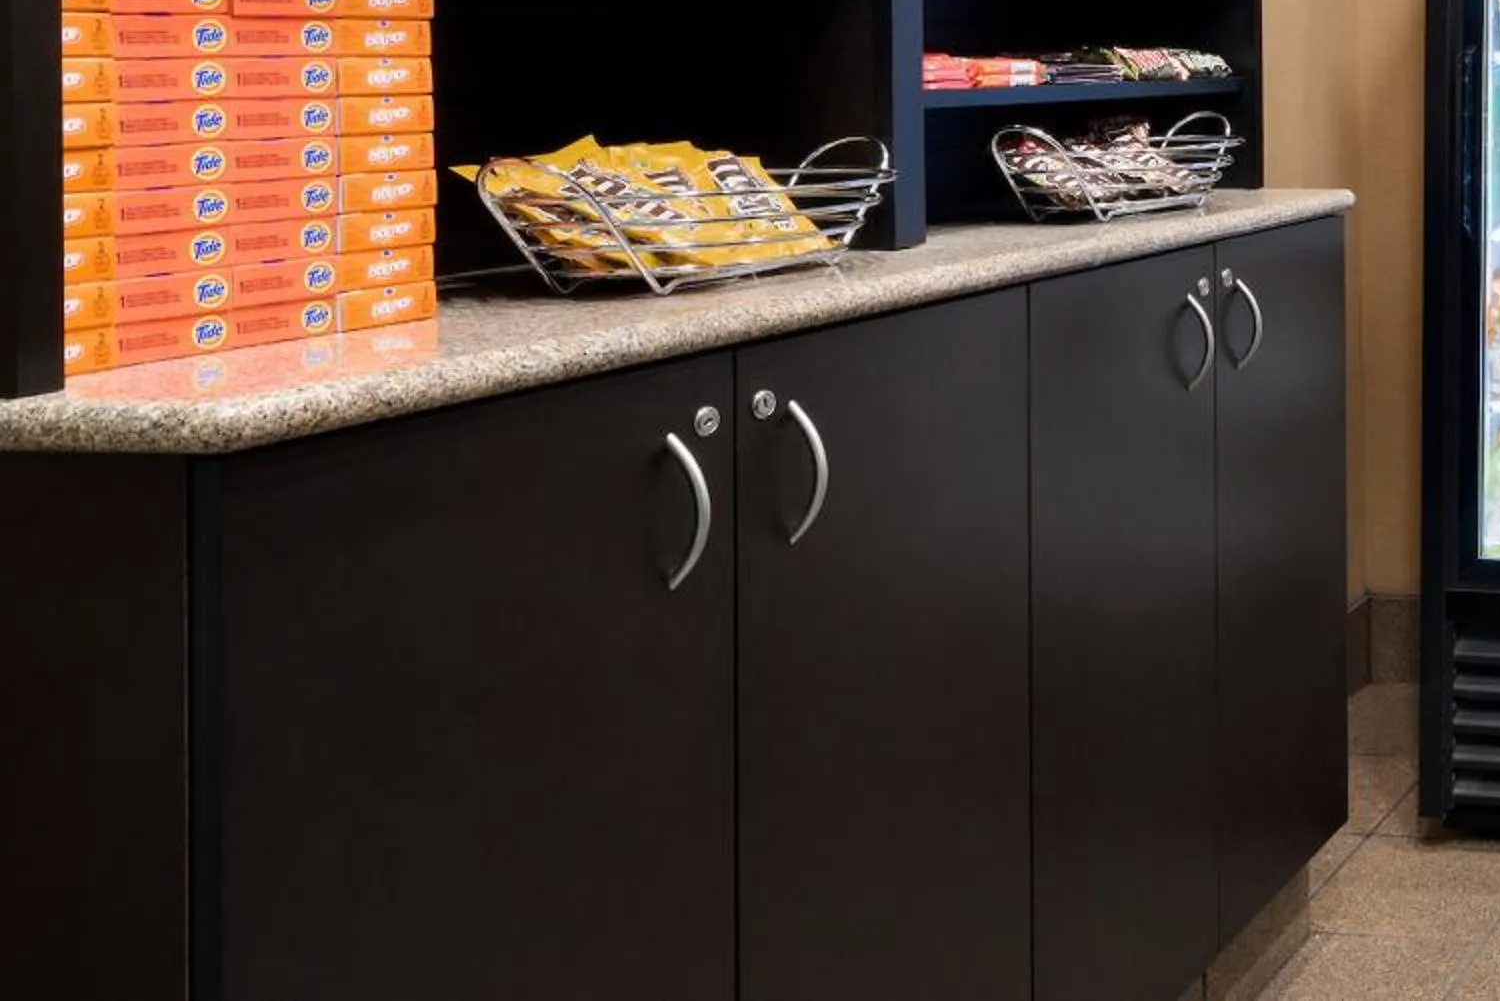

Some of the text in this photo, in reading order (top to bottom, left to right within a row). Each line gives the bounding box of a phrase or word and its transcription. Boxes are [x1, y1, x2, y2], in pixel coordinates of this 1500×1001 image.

[195, 27, 224, 48] Tide
[303, 28, 329, 46] Tide
[195, 69, 223, 90] Tide
[304, 69, 328, 87] Tide
[194, 111, 222, 132] Tide
[303, 109, 328, 127] Tide
[194, 154, 222, 175] Tide
[303, 149, 329, 167] Tide
[196, 197, 224, 218] Tide
[304, 189, 329, 207] Tide
[303, 229, 326, 247] Tide
[193, 239, 221, 260] Tide
[307, 269, 332, 287] Tide
[196, 282, 225, 303] Tide
[303, 309, 328, 327] Tide
[195, 324, 223, 345] Tide
